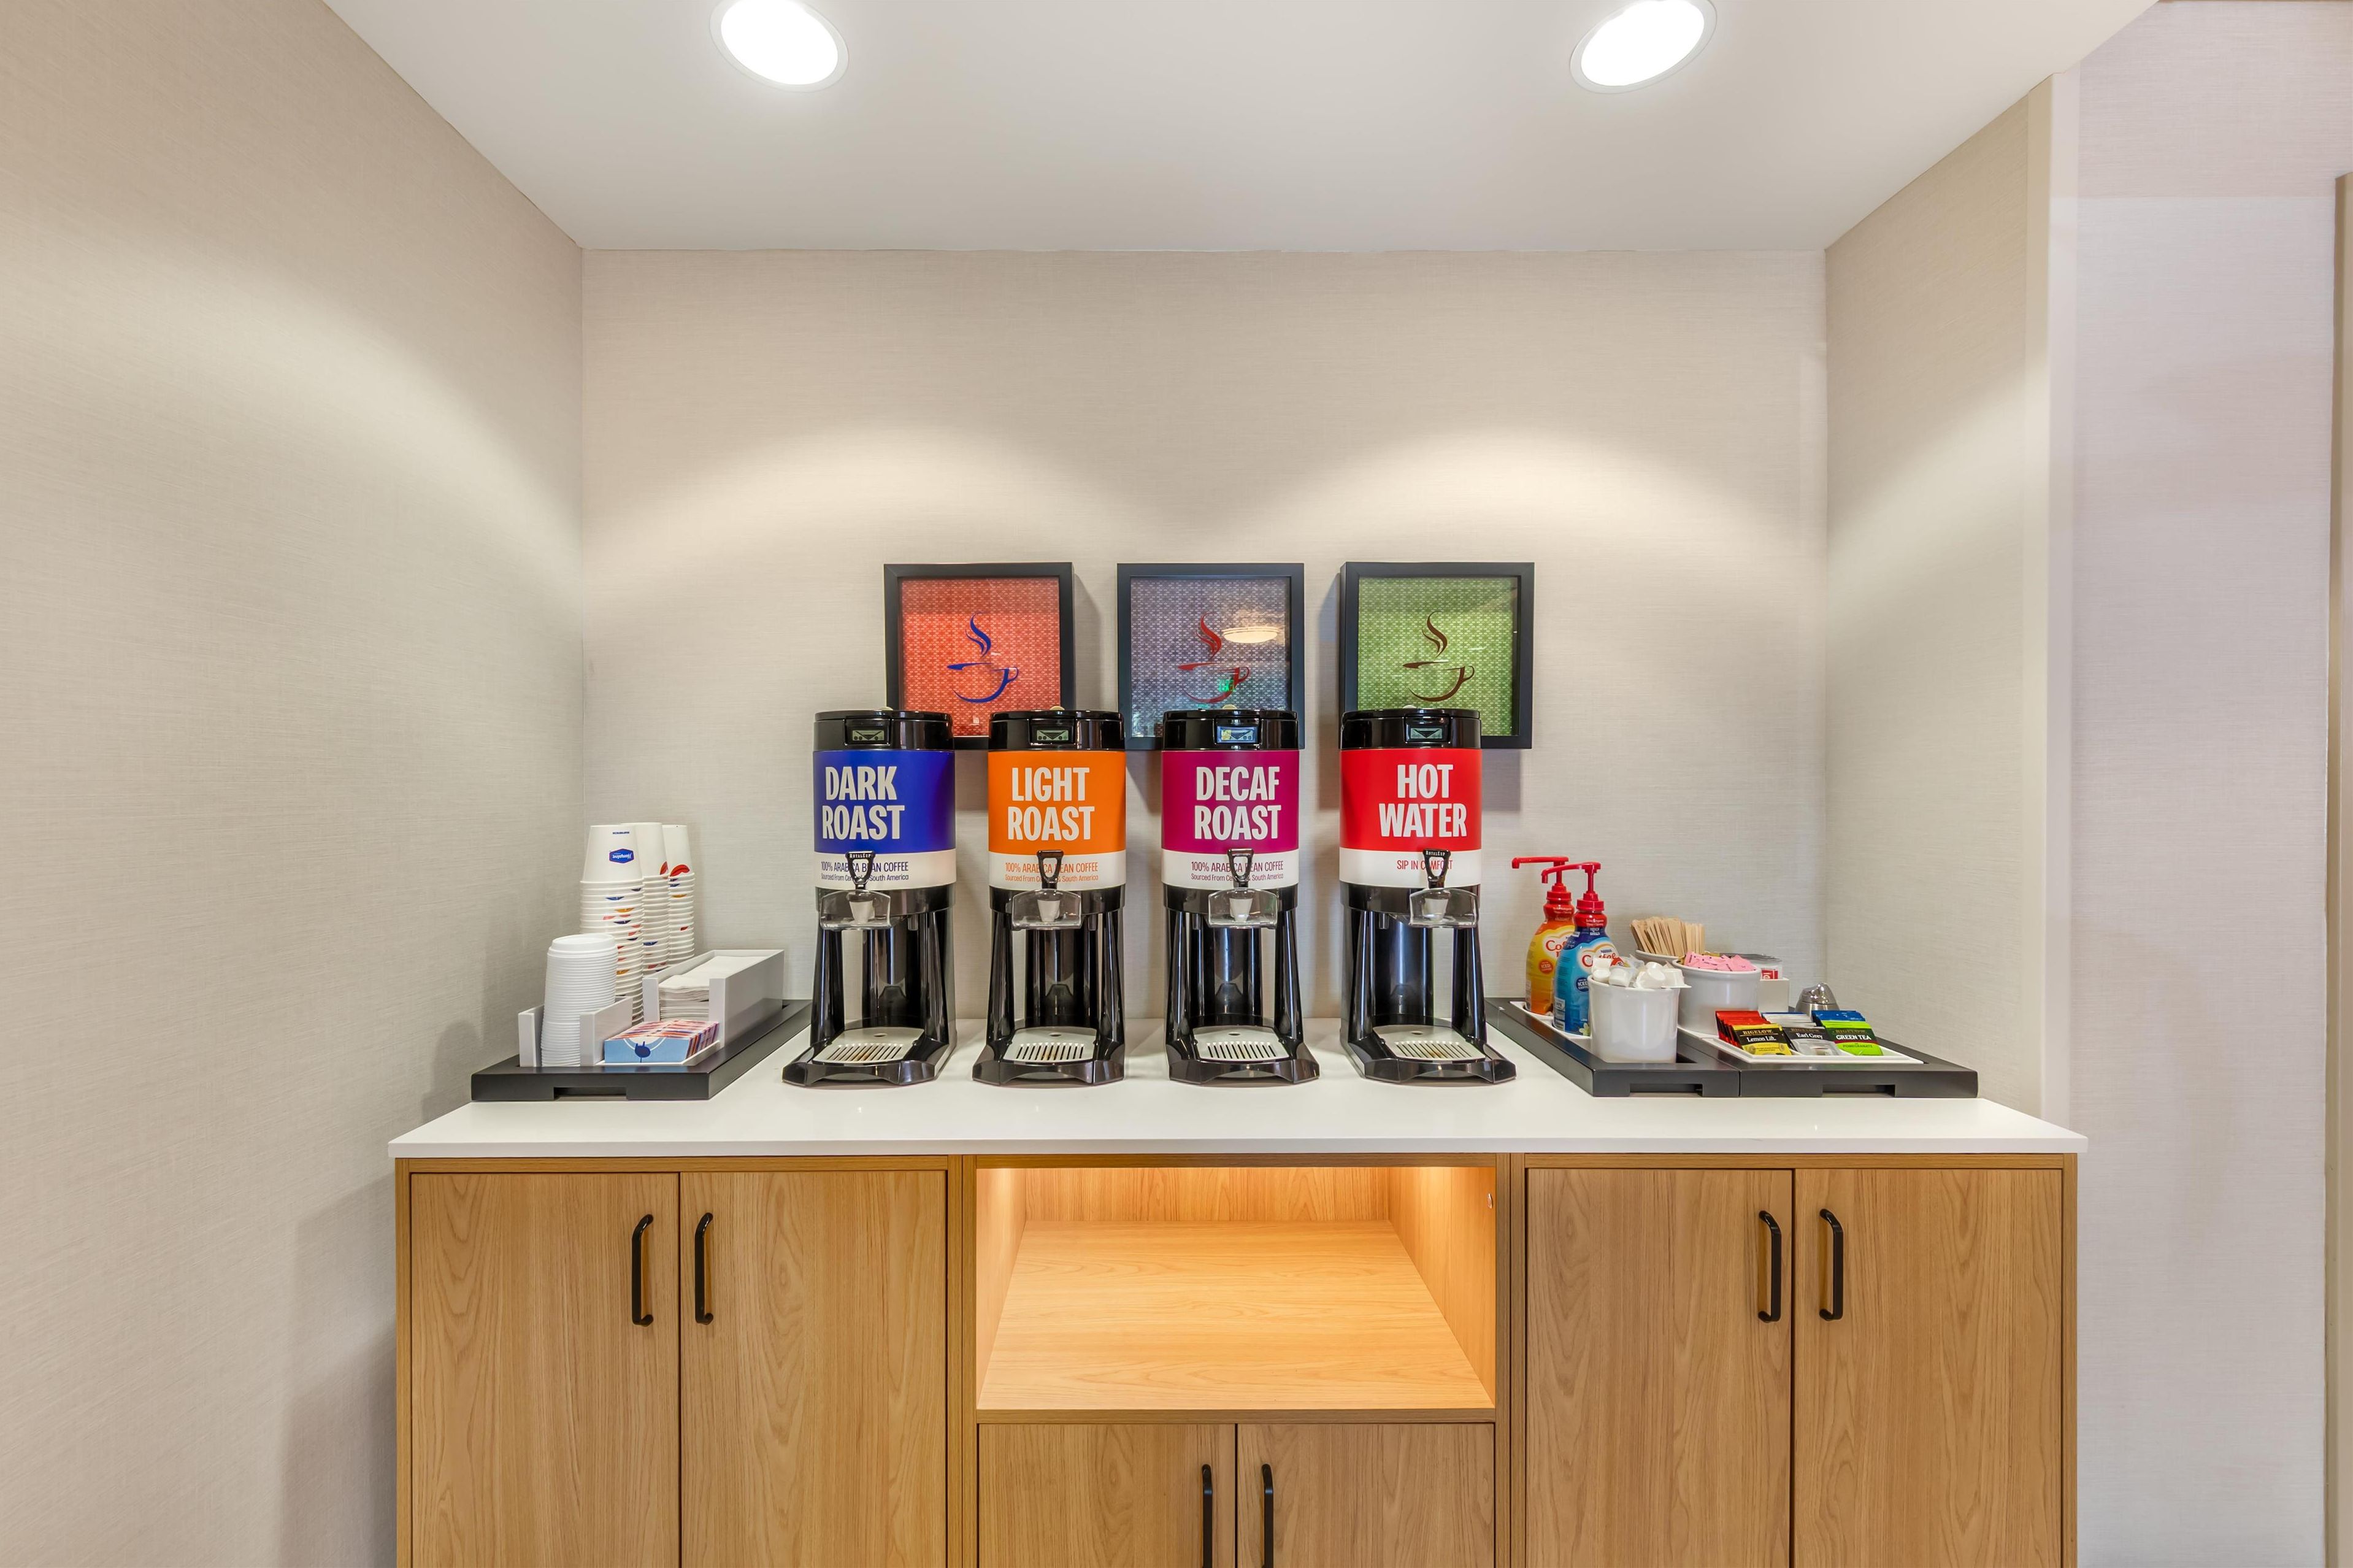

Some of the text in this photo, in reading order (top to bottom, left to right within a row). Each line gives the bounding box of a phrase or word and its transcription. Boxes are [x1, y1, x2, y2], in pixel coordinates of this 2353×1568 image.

[825, 766, 897, 801] DARK
[1012, 767, 1090, 802] LIGHT
[1196, 766, 1280, 801] DECAF
[1397, 764, 1454, 799] HOT
[822, 804, 905, 840] ROAST
[1008, 805, 1096, 841] ROAST
[1194, 805, 1281, 840] ROAST
[1378, 803, 1467, 837] WATER
[821, 861, 908, 872] 100% ARABA BAN COFFEE
[1005, 862, 1098, 873] 100% ARABCA EAN COFFEE
[1191, 861, 1209, 872] 100%
[1211, 862, 1243, 872] ARABCA
[1265, 861, 1283, 870] COFFEE
[1397, 859, 1453, 870] SIP IN CMFOT
